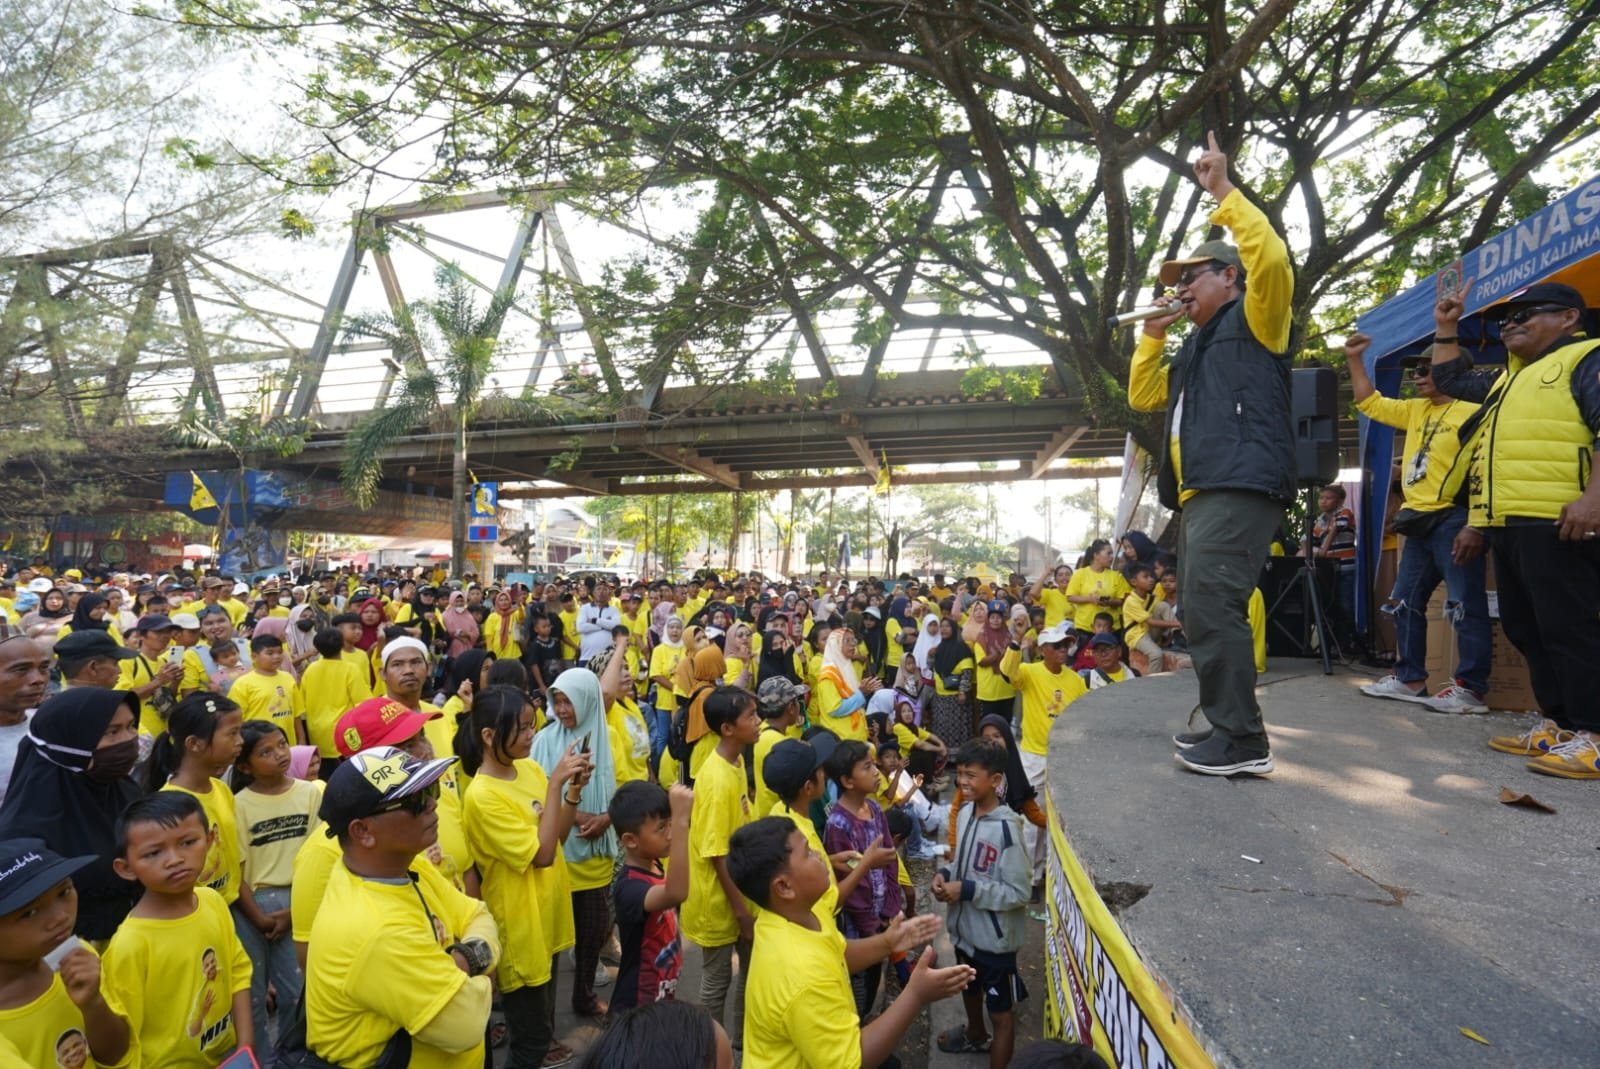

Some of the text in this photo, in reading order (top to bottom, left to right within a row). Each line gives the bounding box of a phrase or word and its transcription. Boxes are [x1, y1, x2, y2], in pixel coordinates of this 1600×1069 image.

[1475, 226, 1600, 302] PROVINSI KALIMA
[1478, 183, 1600, 279] DINAS
